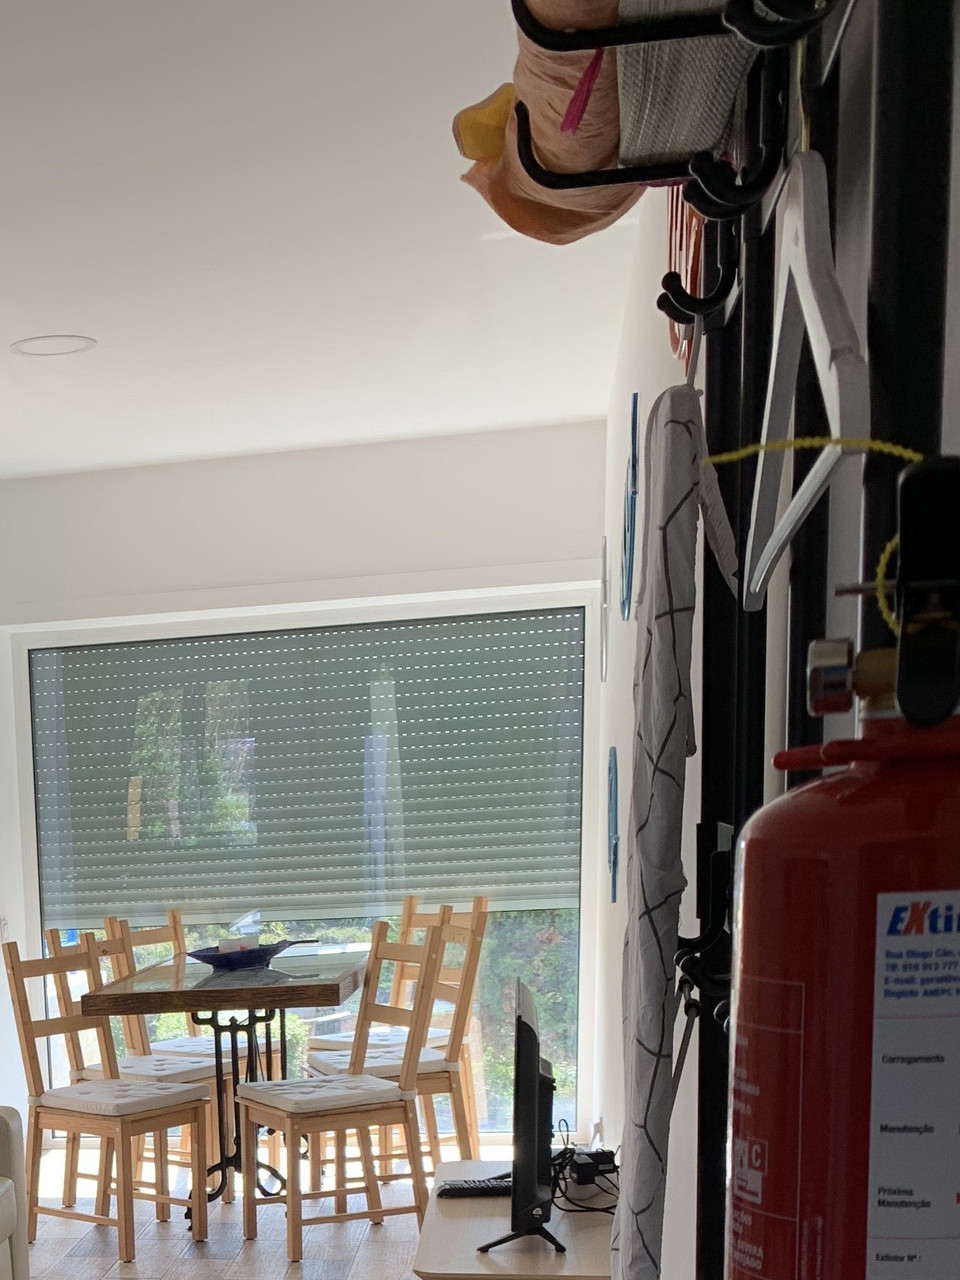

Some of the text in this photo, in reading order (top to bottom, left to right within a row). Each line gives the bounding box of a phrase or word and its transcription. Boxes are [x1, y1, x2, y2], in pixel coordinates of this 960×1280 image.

[881, 1053, 945, 1065] Carregamento
[880, 1124, 934, 1135] Manutenção
[877, 1187, 914, 1197] Próxima
[877, 1199, 932, 1209] Manutenção
[875, 1252, 905, 1262] Extintor
